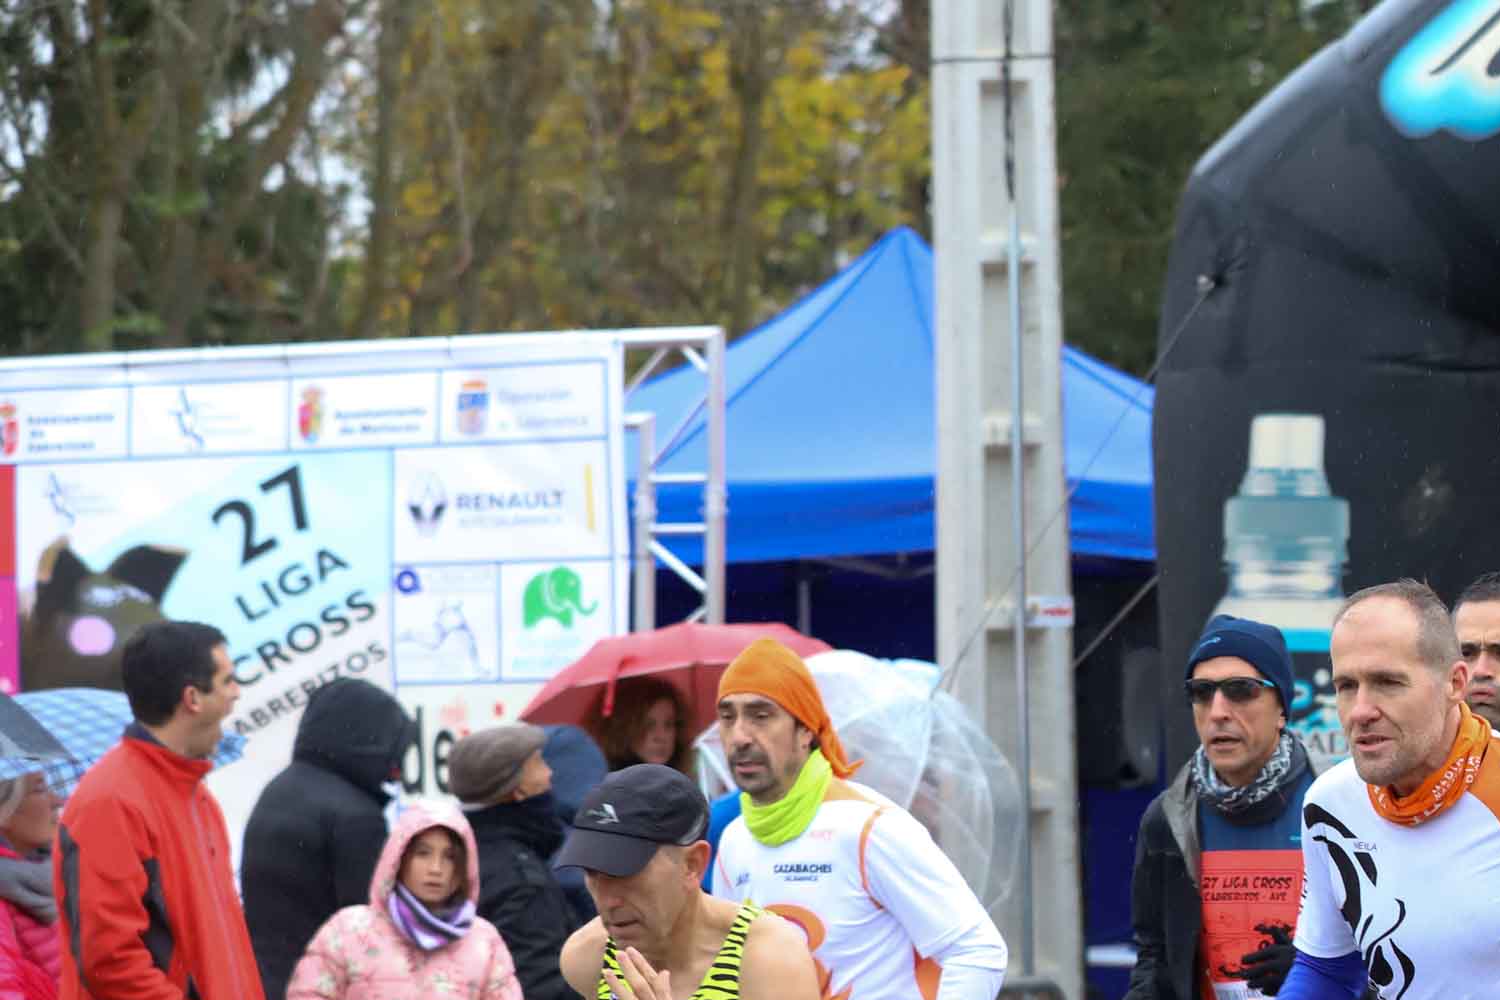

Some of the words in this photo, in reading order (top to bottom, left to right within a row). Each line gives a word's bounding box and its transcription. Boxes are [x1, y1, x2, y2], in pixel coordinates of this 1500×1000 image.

[211, 464, 309, 566] 27
[456, 490, 565, 510] RENAULT
[235, 548, 349, 622] LIGA
[232, 589, 377, 686] CROSS
[230, 643, 387, 736] ABRERIZOS
[1202, 876, 1219, 889] 27
[1222, 876, 1249, 889] LIGA
[1252, 876, 1293, 889] CROSS
